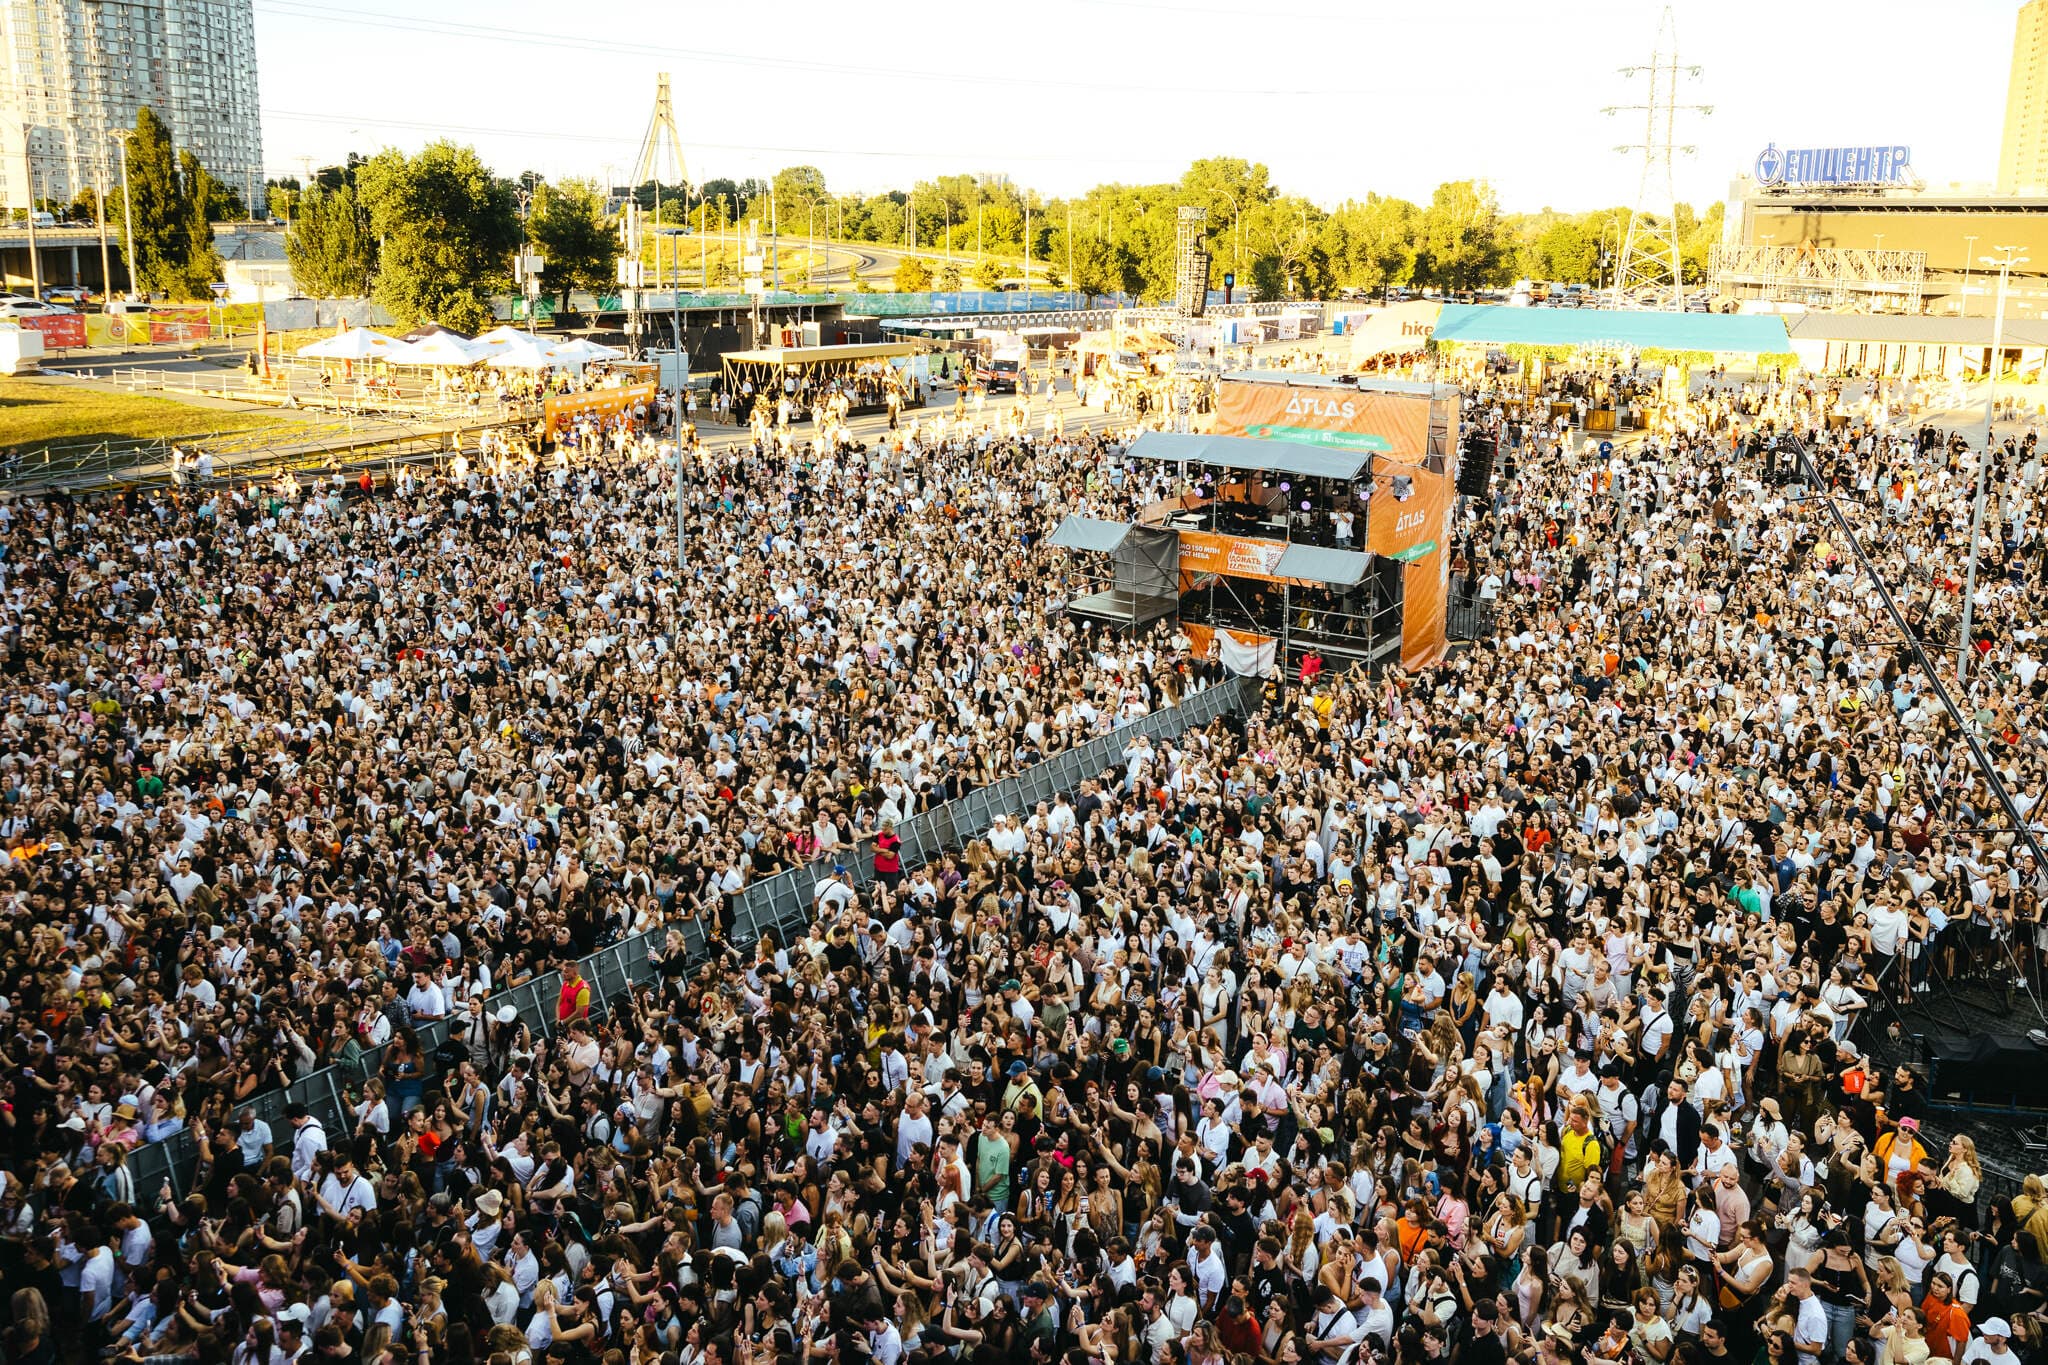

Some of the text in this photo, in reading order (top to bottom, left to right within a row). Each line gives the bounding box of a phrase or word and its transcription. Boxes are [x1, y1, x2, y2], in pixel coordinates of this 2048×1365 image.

[1784, 145, 1909, 184] ЕПІЦЕНТР
[1285, 391, 1356, 419] ATLAS
[1395, 509, 1425, 532] ATLAS
